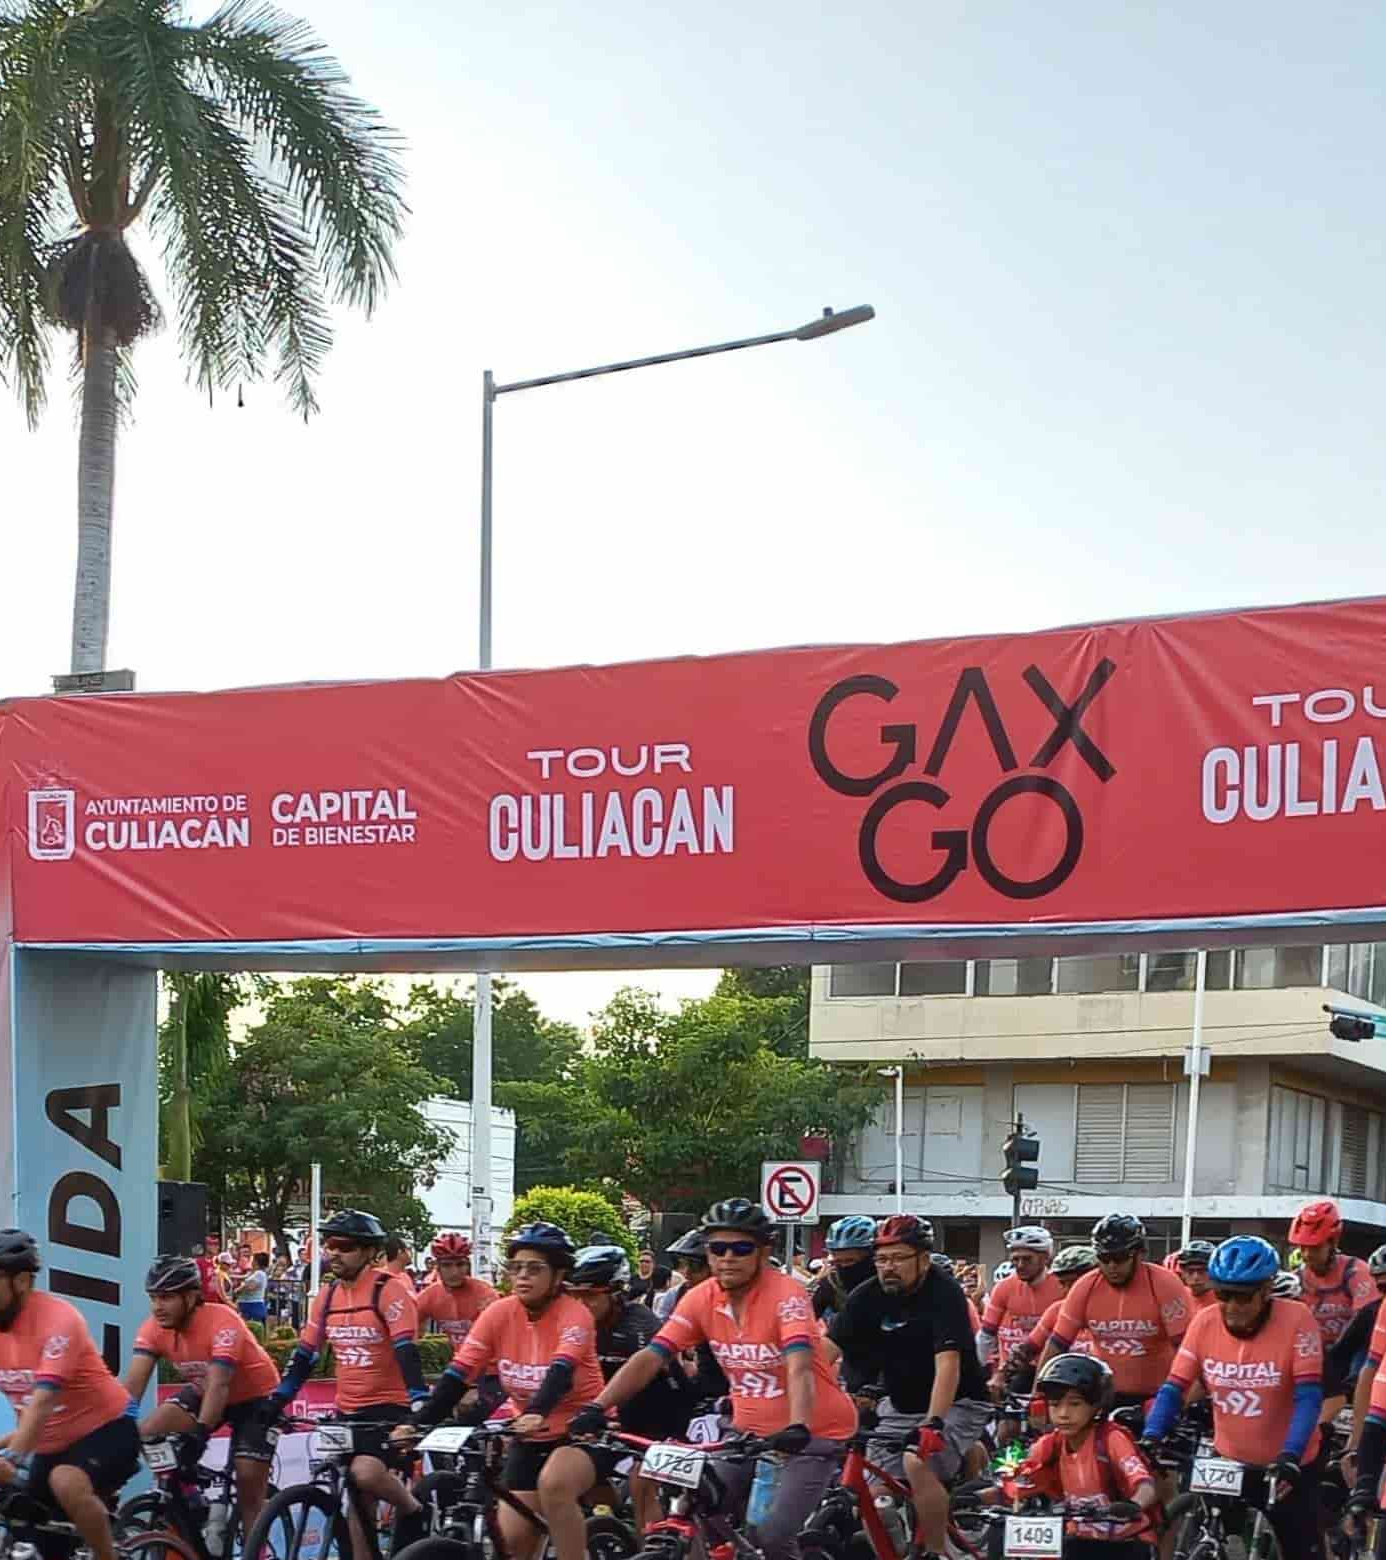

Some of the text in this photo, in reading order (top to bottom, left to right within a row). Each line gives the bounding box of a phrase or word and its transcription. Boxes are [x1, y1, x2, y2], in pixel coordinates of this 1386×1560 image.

[527, 744, 692, 779] TOUR
[85, 795, 247, 815] AYUNTAMIENTO DE
[271, 789, 419, 823] CAPITAL
[85, 814, 250, 850] CULIACÁN
[272, 825, 415, 847] DE BIENESTAR
[489, 785, 735, 863] CULIACAN
[858, 774, 1085, 904] GO
[1203, 1358, 1282, 1379] CAPITAL
[1014, 1527, 1053, 1544] 1409
